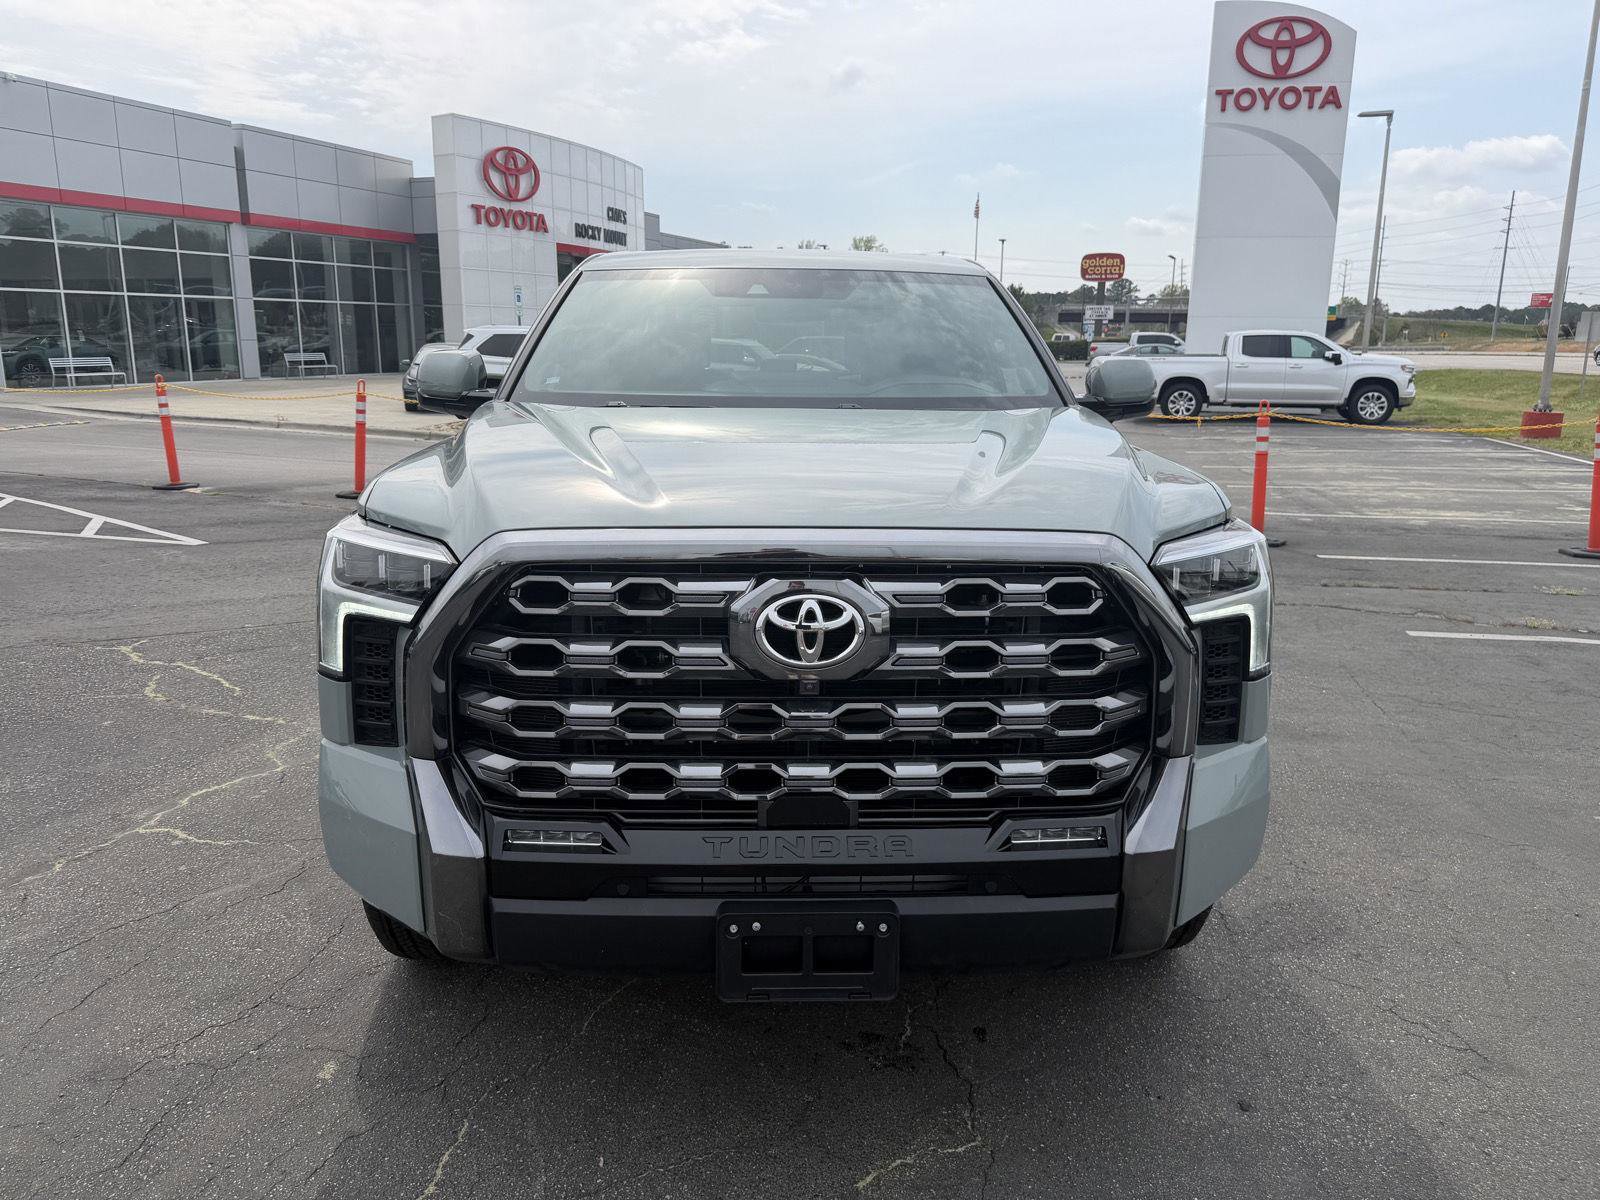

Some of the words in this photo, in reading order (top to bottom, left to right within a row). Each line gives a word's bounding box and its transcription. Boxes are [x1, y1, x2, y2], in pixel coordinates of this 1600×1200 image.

[1215, 86, 1342, 112] TOYOTA
[471, 204, 549, 233] TOYOTA
[575, 222, 602, 241] ROCKY
[603, 228, 627, 247] MOUNT
[1082, 257, 1120, 269] golden
[1087, 264, 1124, 274] corral
[702, 835, 915, 858] TUNDRA
